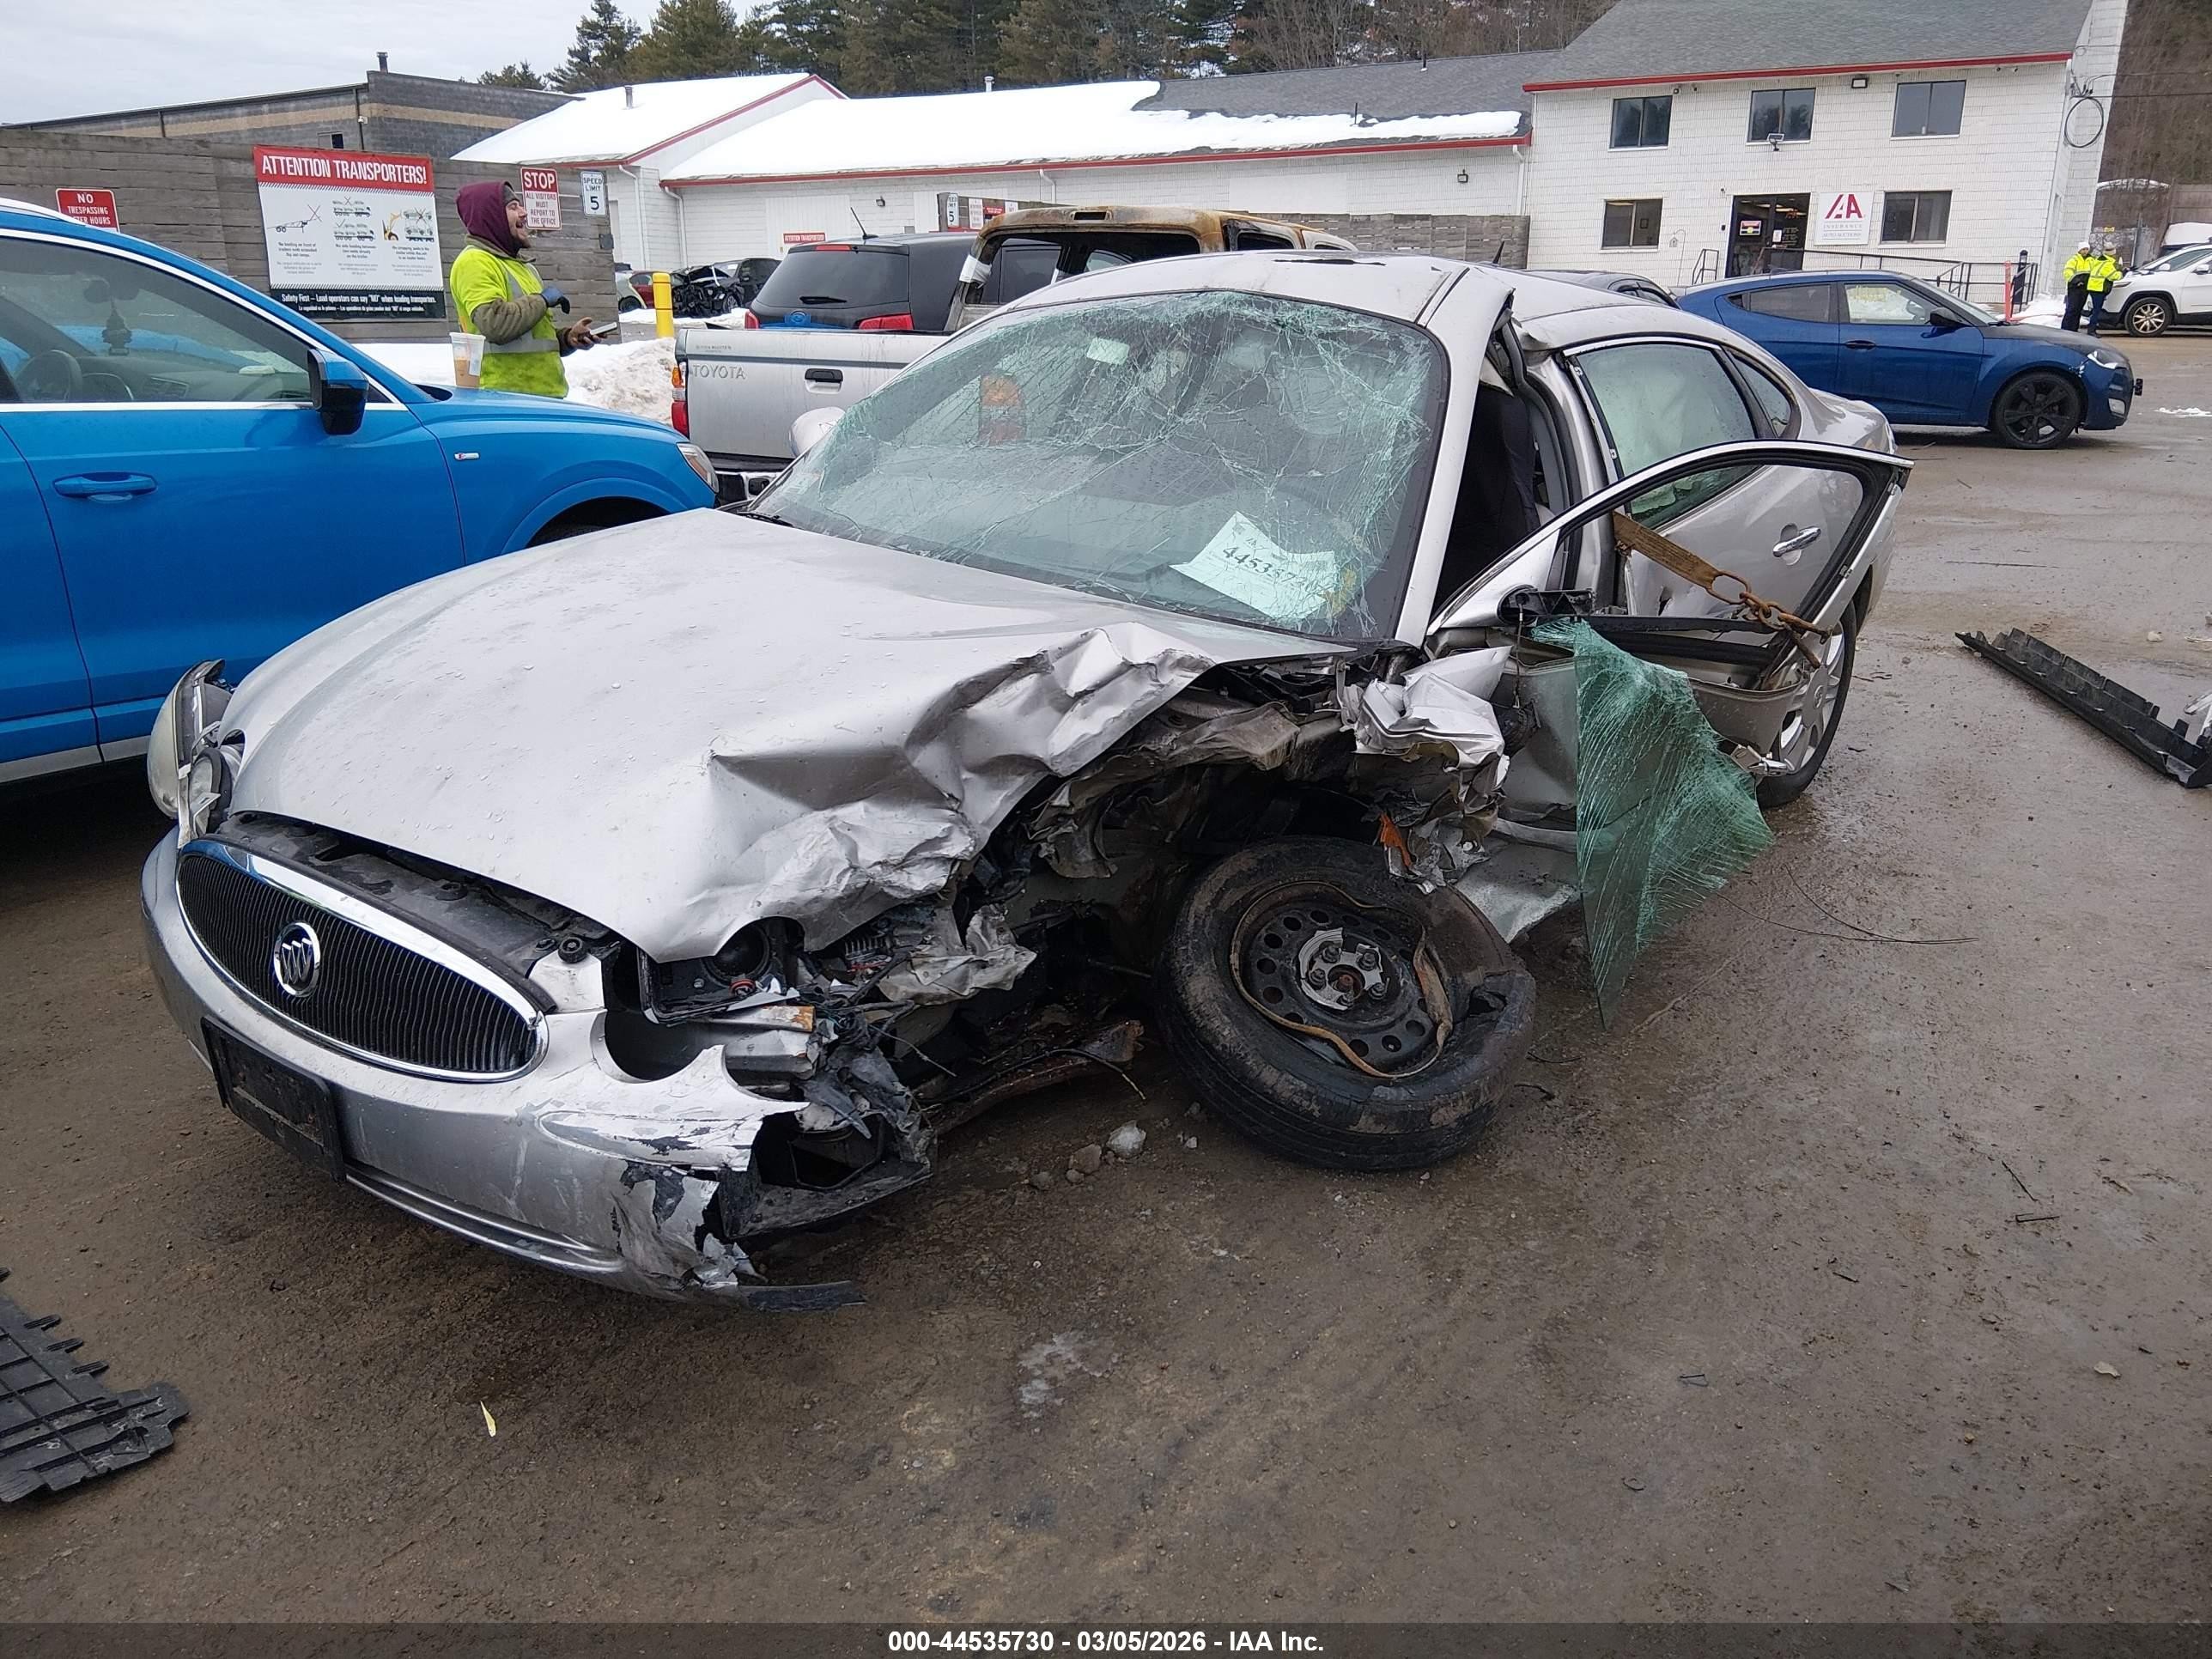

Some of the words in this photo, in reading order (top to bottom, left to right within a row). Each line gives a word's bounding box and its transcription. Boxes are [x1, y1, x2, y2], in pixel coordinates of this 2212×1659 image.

[262, 155, 331, 178] ATTENTION
[333, 160, 427, 184] TRANSPORTERS!
[524, 171, 555, 189] STOP
[77, 193, 94, 204] NO
[590, 196, 599, 210] 5
[68, 206, 109, 215] TRESPASSING
[89, 216, 111, 225] HOURS
[949, 211, 955, 222] 5
[282, 293, 298, 303] Safety
[299, 294, 309, 302] First
[328, 295, 350, 303] operators
[394, 295, 410, 304] loading
[693, 364, 746, 380] TOYOTA
